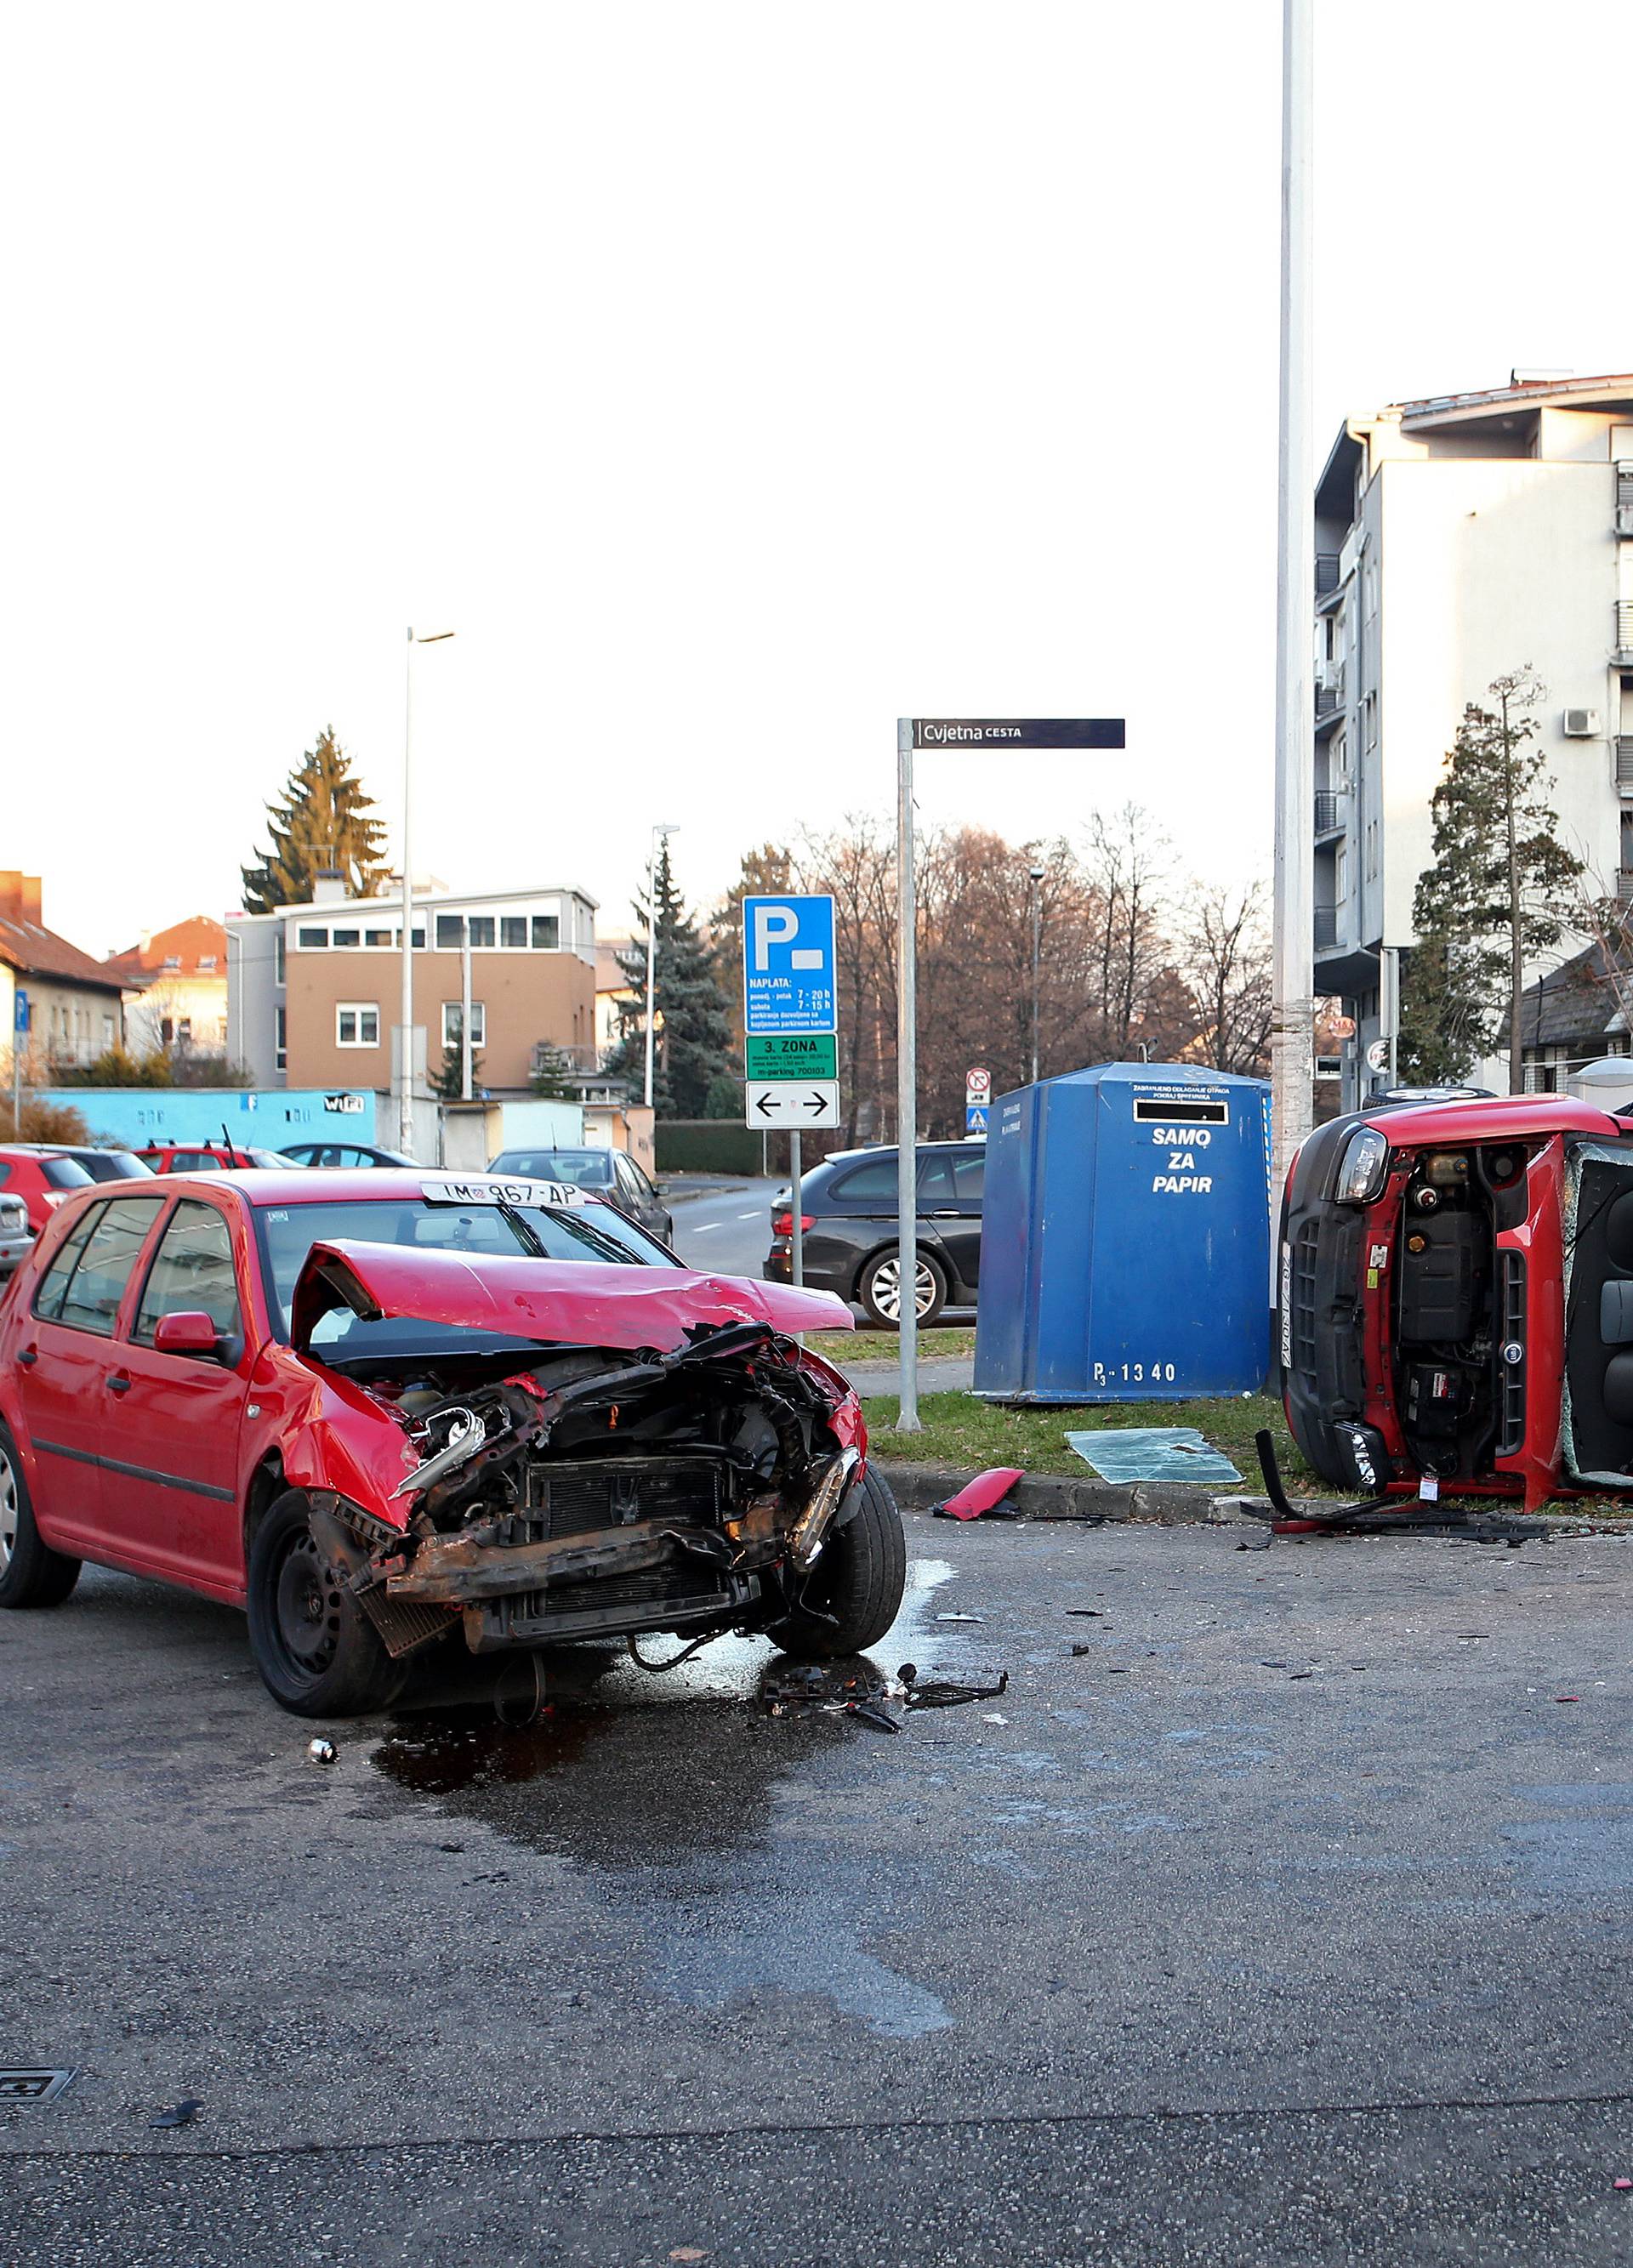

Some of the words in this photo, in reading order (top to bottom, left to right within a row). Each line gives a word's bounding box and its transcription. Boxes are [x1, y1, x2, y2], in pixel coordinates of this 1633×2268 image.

[924, 725, 982, 743] Cvjetna
[985, 729, 1021, 737] CESTA
[754, 906, 799, 971] P
[749, 978, 792, 988] NAPLATA:
[798, 989, 804, 998] 7
[811, 990, 823, 1000] 20
[824, 988, 831, 998] h
[798, 1000, 804, 1009] 7
[811, 1000, 822, 1010] 15
[824, 999, 831, 1009] h
[765, 1041, 776, 1054] 3.
[782, 1040, 817, 1052] ZONA
[1152, 1128, 1211, 1145] SAMO
[1168, 1152, 1195, 1169] ZA
[1152, 1176, 1213, 1193] PAPIR
